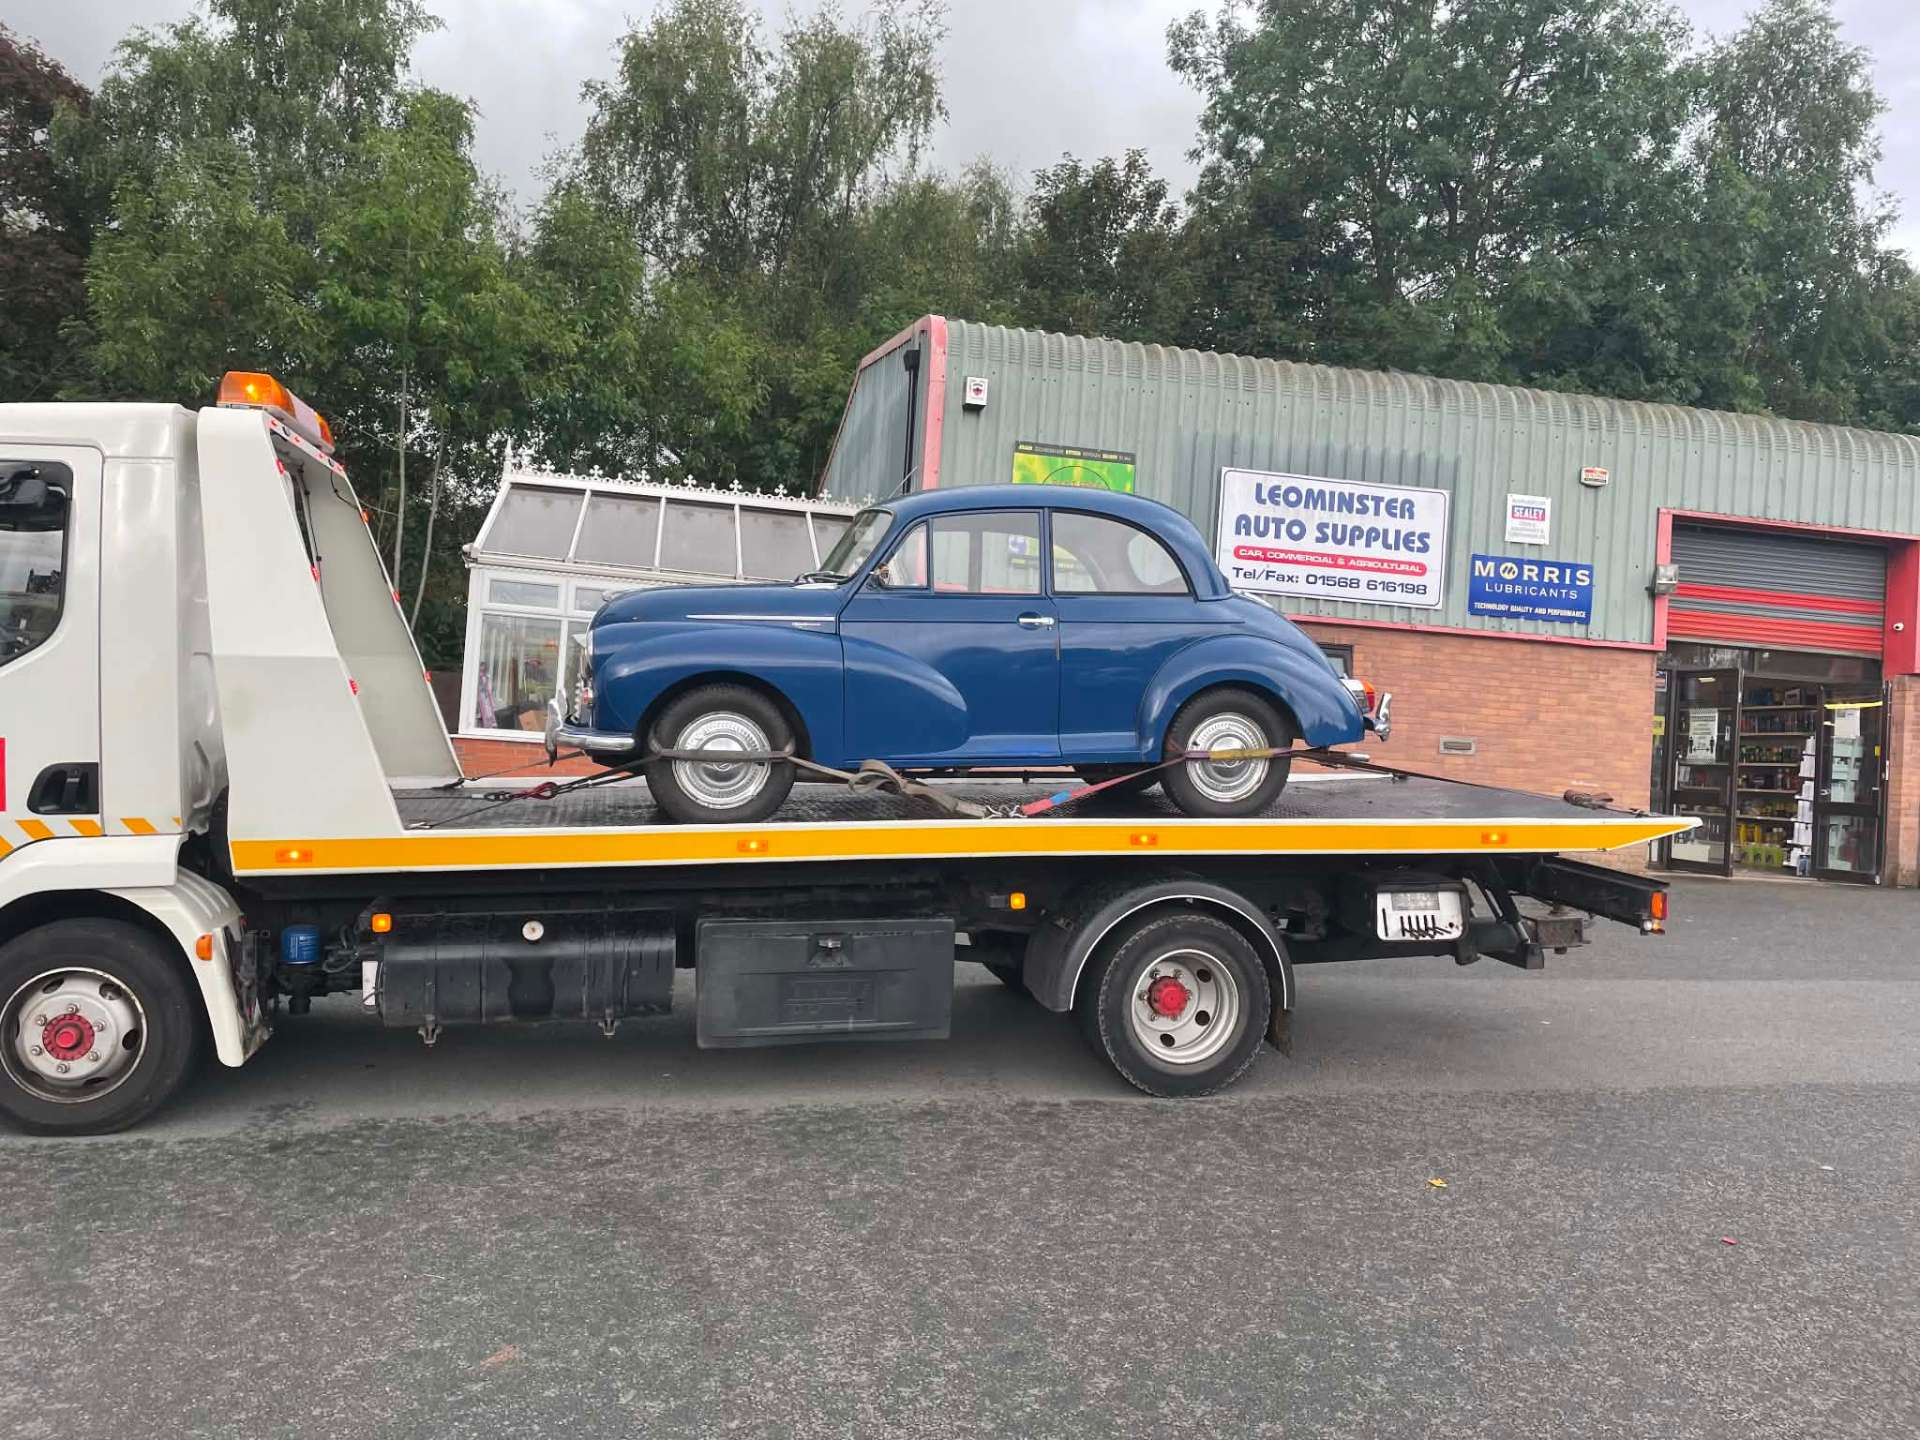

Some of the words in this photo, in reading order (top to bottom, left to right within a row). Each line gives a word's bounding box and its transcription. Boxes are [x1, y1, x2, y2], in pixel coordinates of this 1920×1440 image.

[1255, 482, 1415, 520] LEOMINSTER
[1513, 506, 1544, 520] SEALEY
[1234, 514, 1306, 541] AUTO
[1315, 522, 1430, 553] SUPPLIES
[1267, 551, 1334, 564] COMMERCIAL
[1349, 559, 1422, 573] AGRICULTURAL
[1474, 560, 1590, 586] MORRIS
[1232, 567, 1299, 584] Tel/Fax:
[1306, 574, 1360, 589] 01568
[1366, 580, 1427, 595] 616198
[1485, 582, 1578, 600] LUBRICANTS
[1474, 602, 1509, 612] TECHNOLOGY
[1510, 605, 1533, 613] QUALITY
[1534, 607, 1547, 615] AND
[1547, 608, 1586, 618] PERFORMANCE
